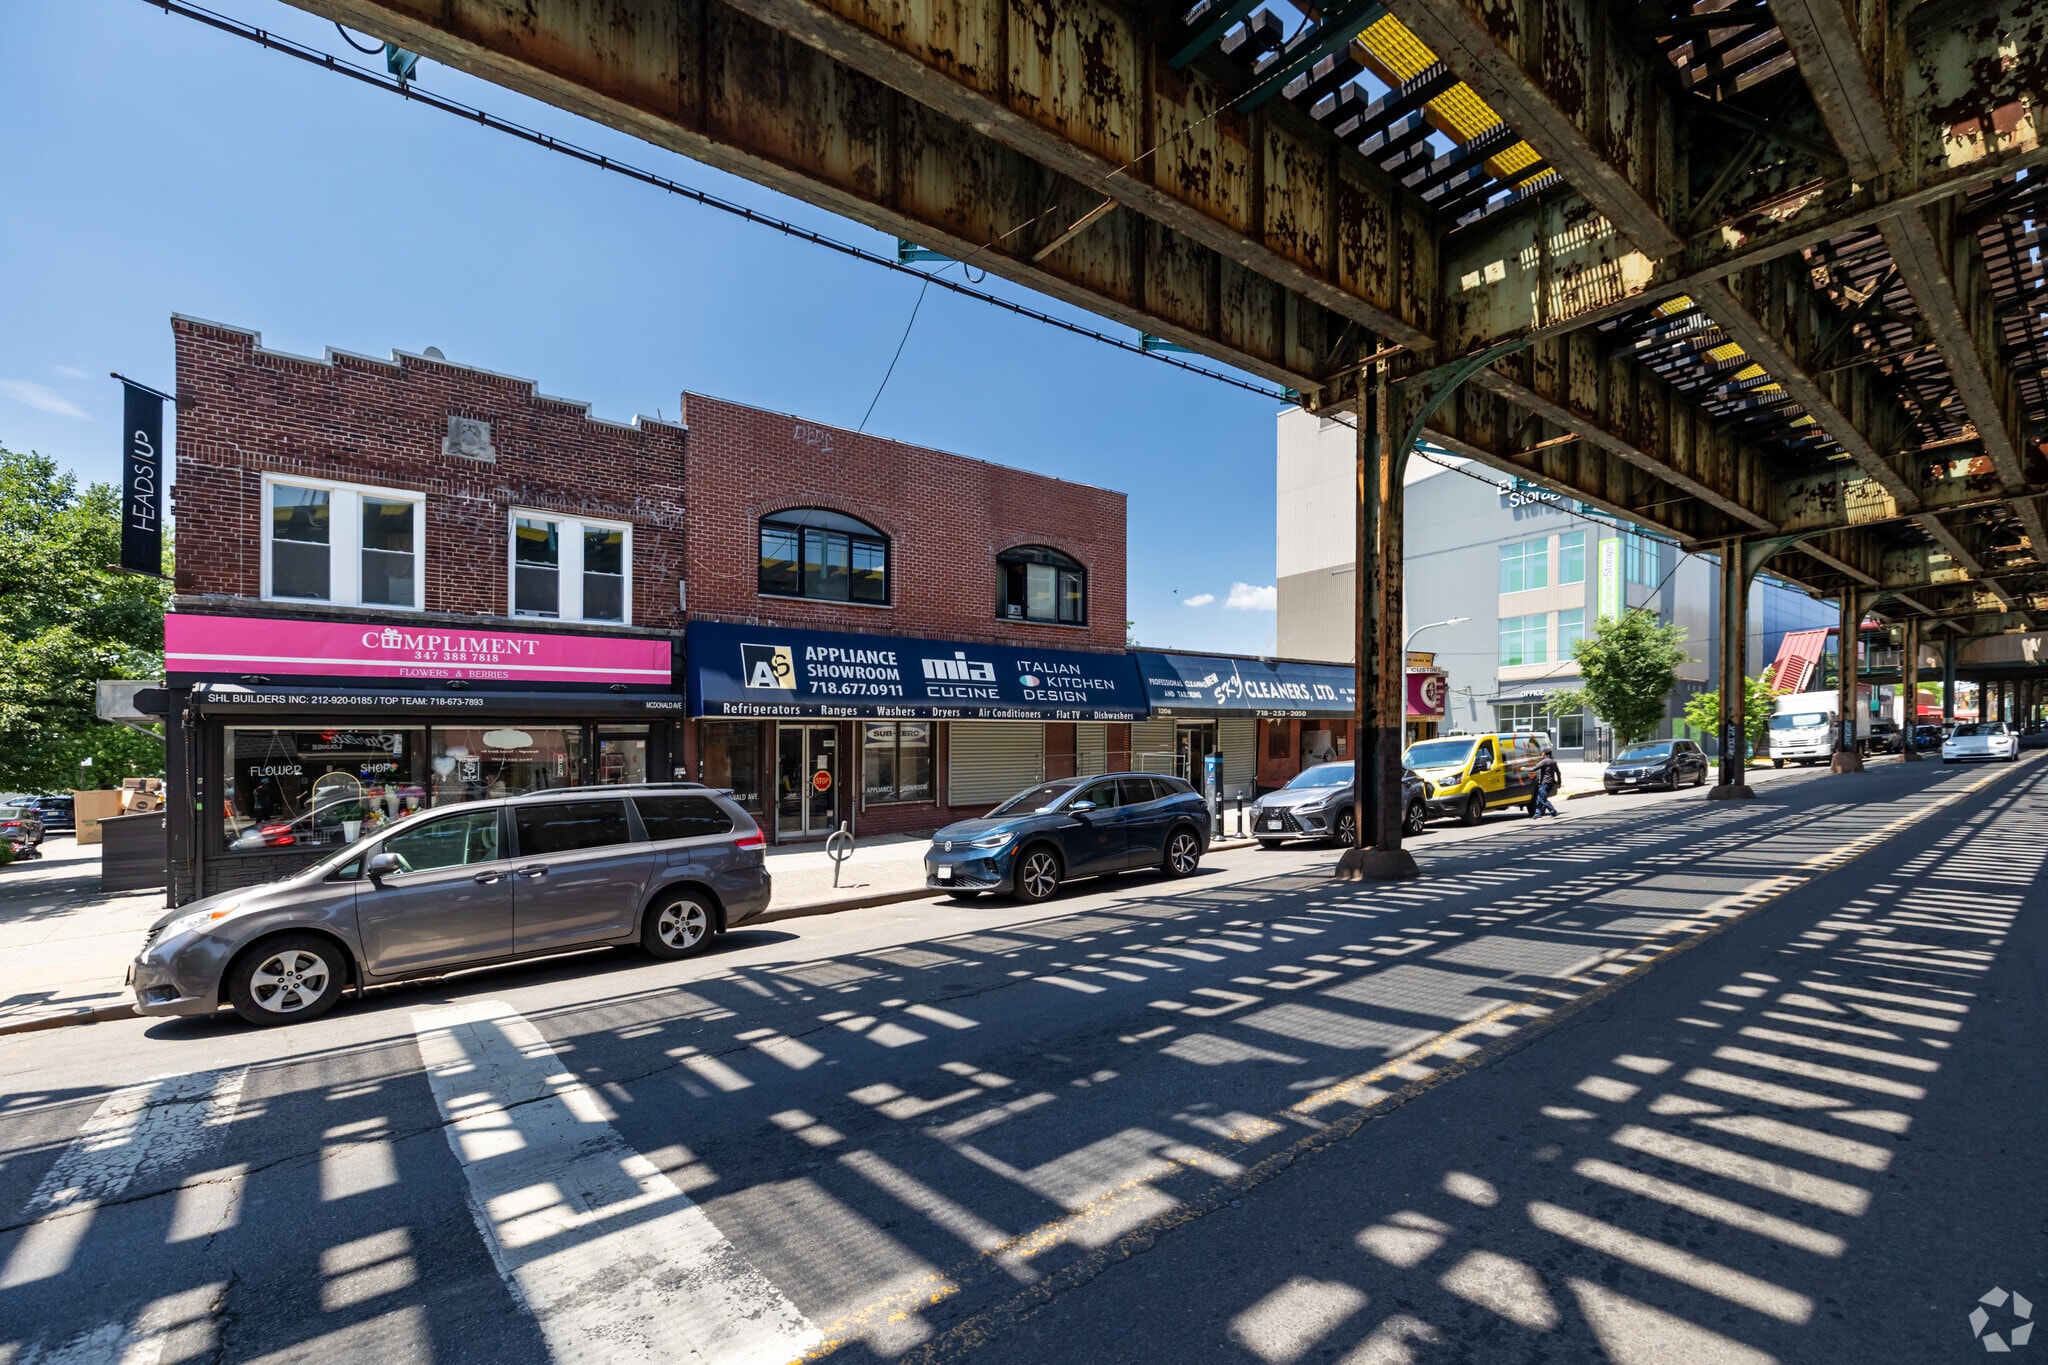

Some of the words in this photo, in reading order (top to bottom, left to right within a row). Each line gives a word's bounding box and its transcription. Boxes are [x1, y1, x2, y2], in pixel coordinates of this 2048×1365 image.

[415, 651, 438, 660] 347
[443, 652, 467, 661] 388
[472, 653, 499, 663] 7818
[805, 646, 898, 666] APPLIANCE
[807, 664, 900, 681] SHOWROOM
[921, 651, 997, 681] mia
[1016, 660, 1081, 675] ITALIAN
[399, 668, 449, 678] FLOWERS
[455, 670, 462, 678] &
[469, 670, 509, 679] BERRIES
[809, 681, 904, 697] 718.677.0911
[1046, 676, 1115, 690] KITCHEN
[1149, 678, 1183, 687] PROFESSIONAL
[926, 686, 1000, 699] CUCINE
[1023, 689, 1087, 702] DESIGN
[1244, 681, 1313, 702] CLEANERS,
[1313, 684, 1338, 701] LTD.
[1520, 689, 1545, 697] OFFICE
[208, 694, 230, 703] SHL
[232, 694, 287, 704] BUILDERS
[288, 695, 309, 704] INC:
[311, 696, 372, 705] 212-920-0185
[379, 697, 399, 705] TOP
[400, 697, 428, 705] TEAM:
[430, 697, 484, 706] 718-673-7893
[723, 703, 800, 716] Refrigerators
[820, 704, 858, 716] Ranges
[876, 706, 916, 717] Washers
[932, 707, 960, 718] Dryers
[978, 708, 991, 717] Air
[992, 709, 1041, 719] Conditioners
[1056, 710, 1070, 719] Flat
[1071, 710, 1081, 719] TV
[1094, 711, 1134, 720] Dishwashers
[815, 777, 830, 785] STOP
[866, 786, 893, 794] APPLIANCE
